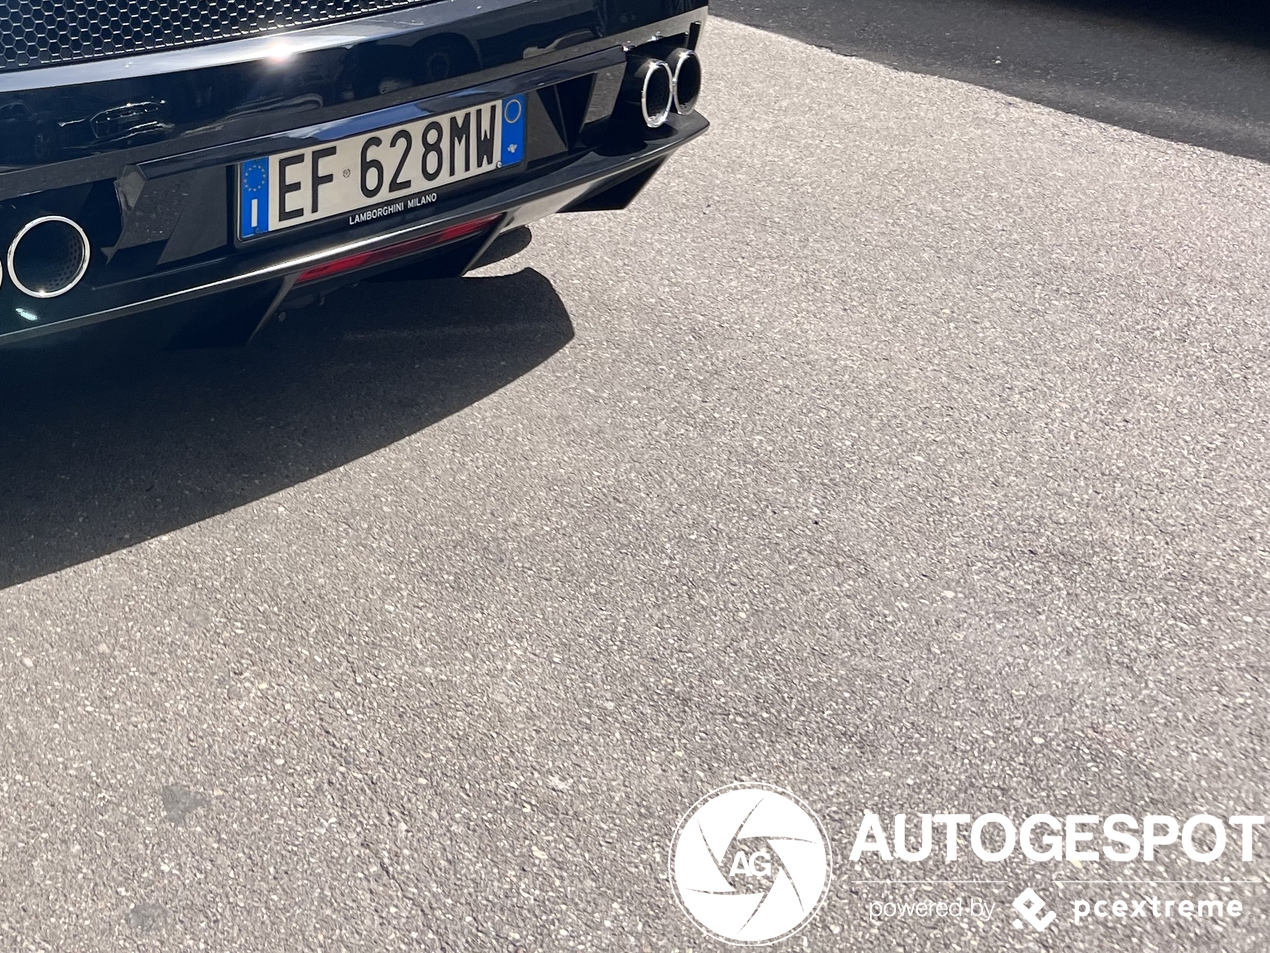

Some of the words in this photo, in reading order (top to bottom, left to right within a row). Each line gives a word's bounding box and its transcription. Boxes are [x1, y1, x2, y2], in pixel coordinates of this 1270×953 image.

[279, 146, 337, 222] EF
[360, 104, 497, 198] 628MW
[349, 201, 404, 226] LAMBORGHINI
[407, 192, 437, 210] MILANO
